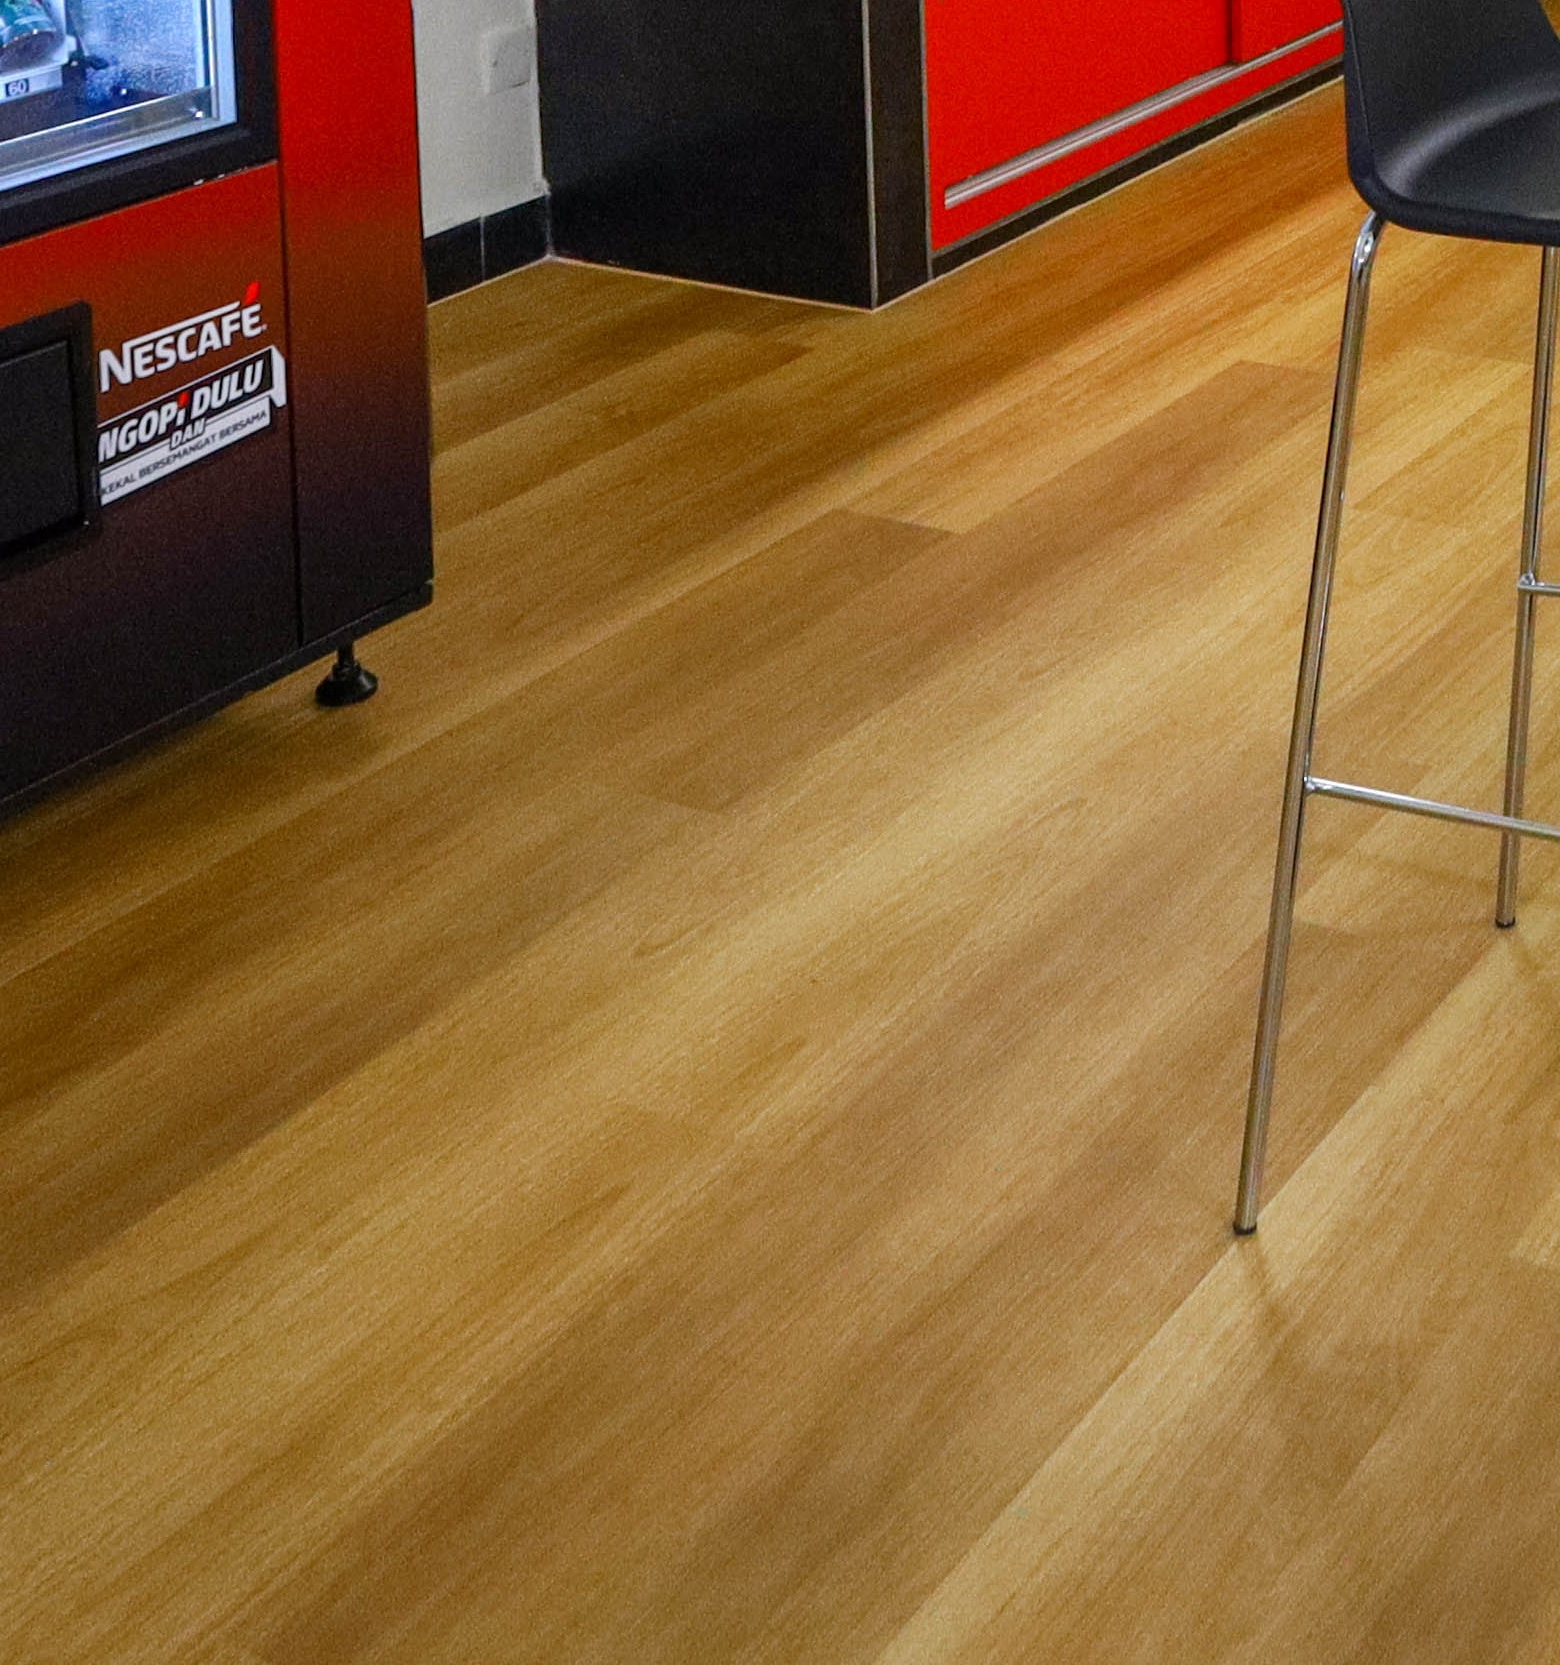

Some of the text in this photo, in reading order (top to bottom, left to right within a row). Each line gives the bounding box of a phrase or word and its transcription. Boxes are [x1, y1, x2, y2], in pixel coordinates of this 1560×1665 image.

[7, 80, 28, 96] 60
[190, 359, 265, 421] DULU
[101, 410, 267, 497] KEKAL BERSEMANGAT BERSAMA
[170, 418, 207, 450] DAN
